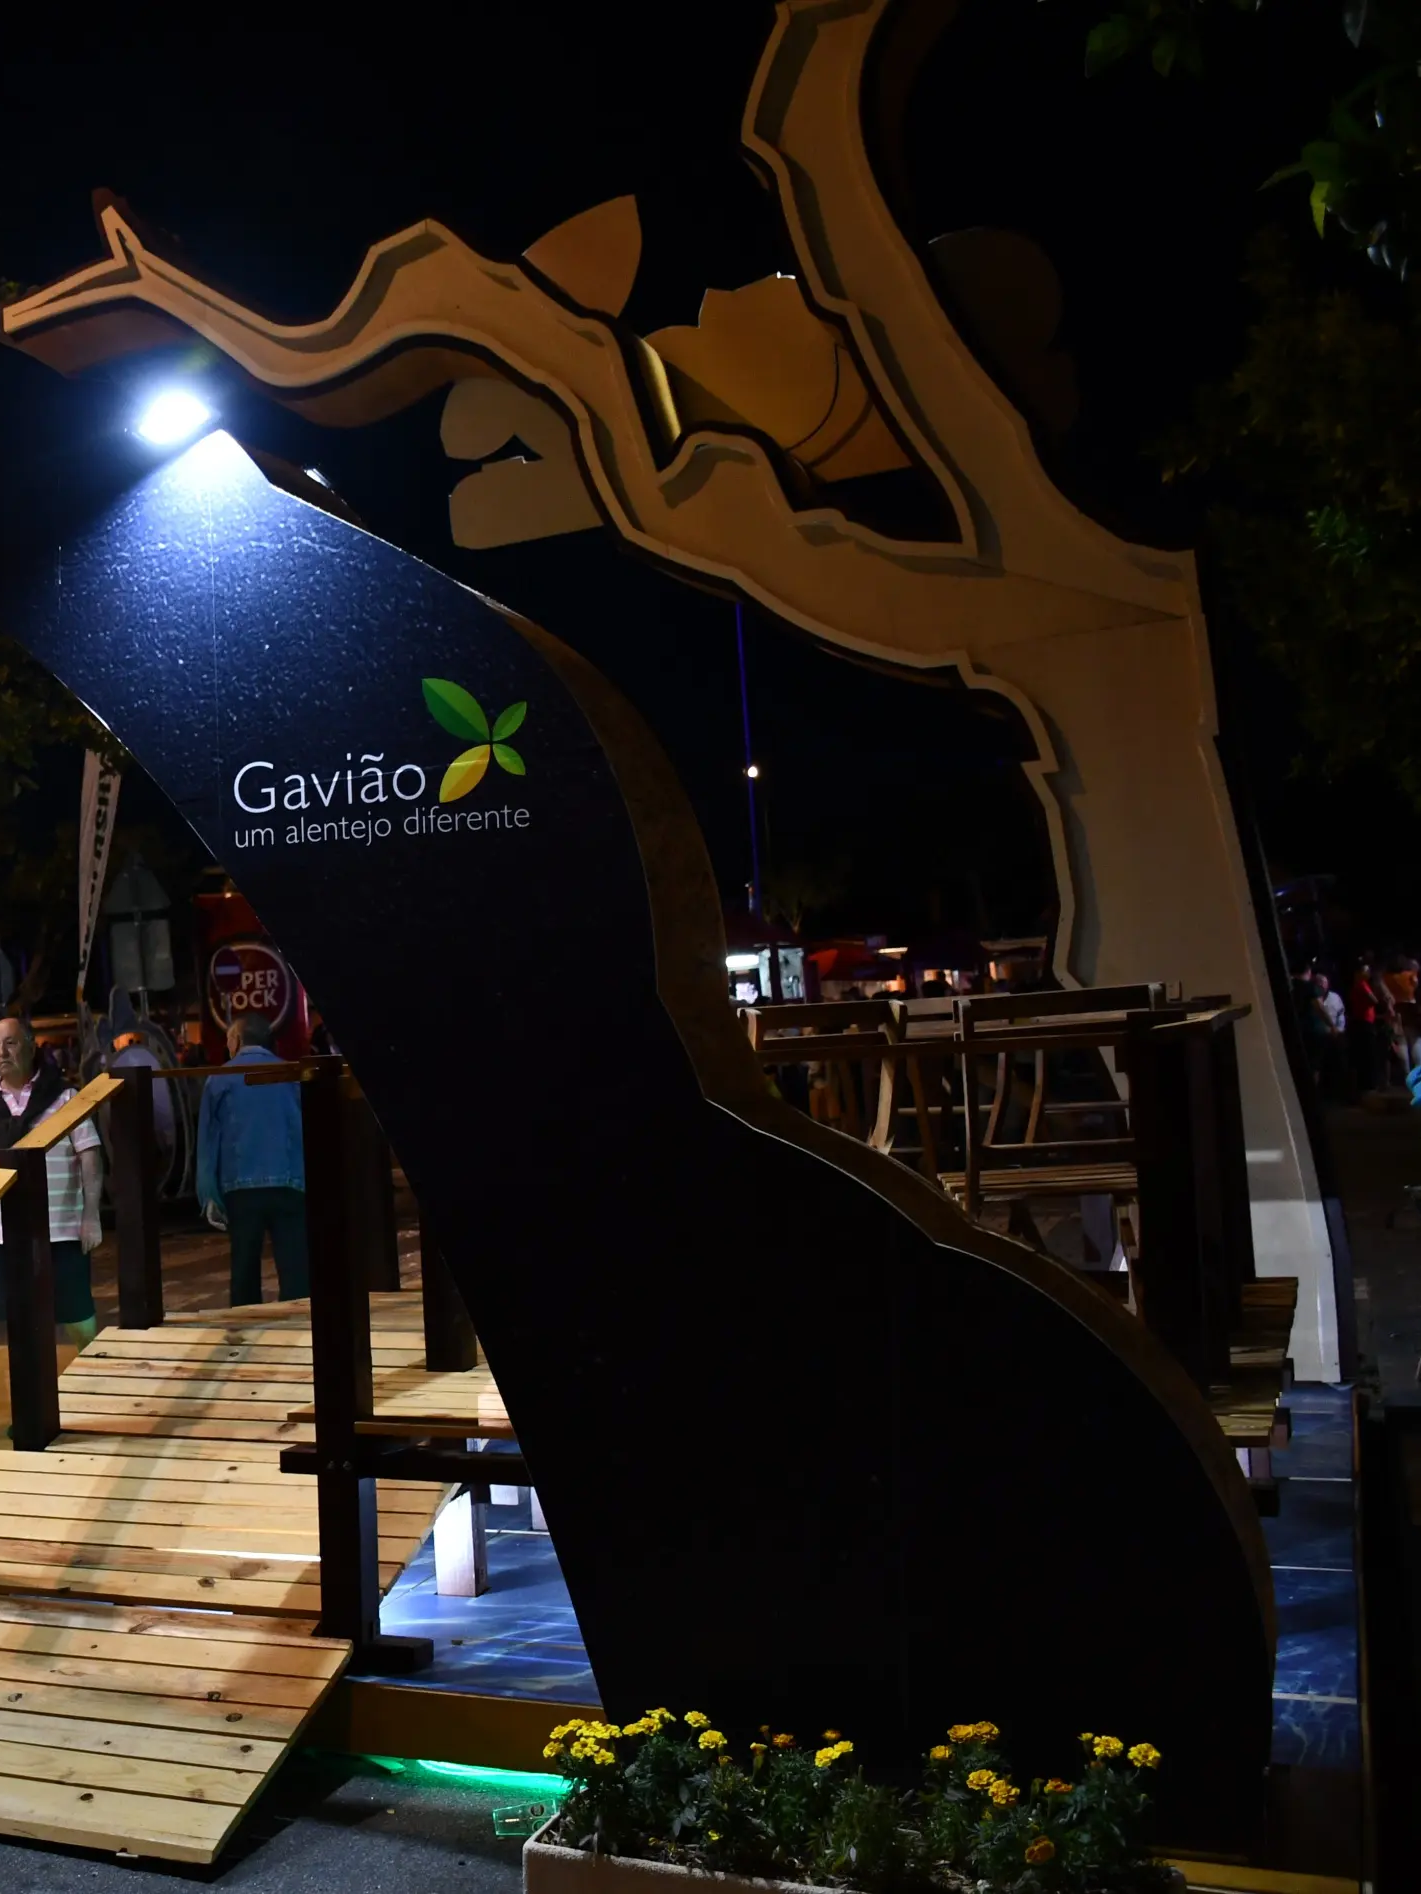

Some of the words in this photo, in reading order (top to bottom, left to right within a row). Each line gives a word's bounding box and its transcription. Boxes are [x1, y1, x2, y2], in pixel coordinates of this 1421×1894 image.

[233, 752, 426, 813] Gavião
[234, 827, 275, 848] um
[285, 811, 392, 846] alentejo
[403, 804, 531, 834] diferente
